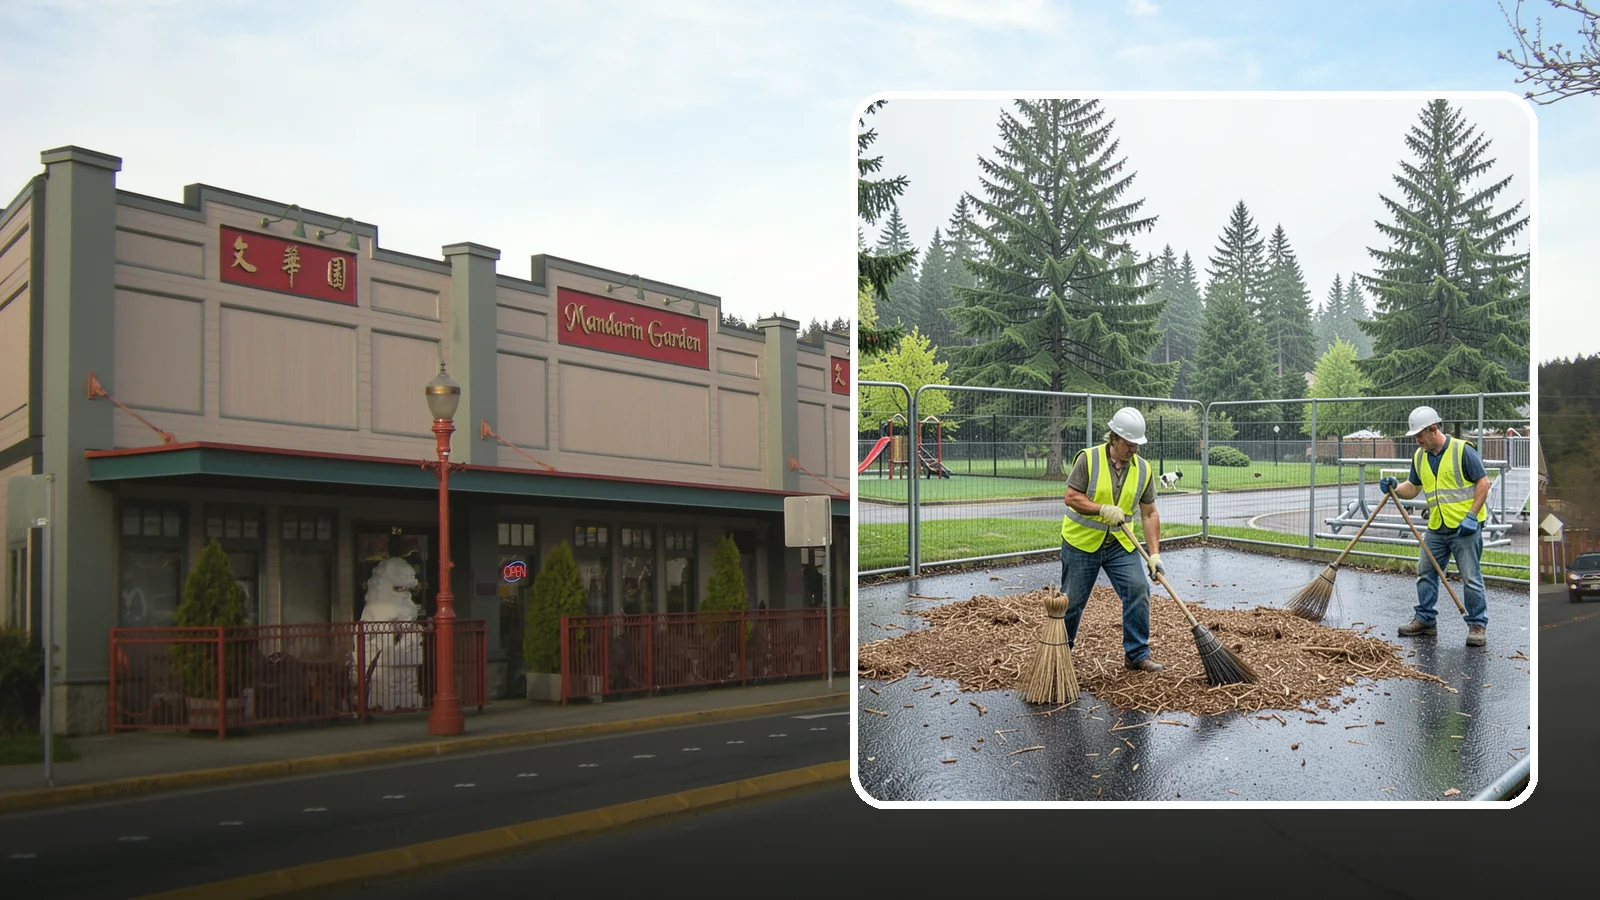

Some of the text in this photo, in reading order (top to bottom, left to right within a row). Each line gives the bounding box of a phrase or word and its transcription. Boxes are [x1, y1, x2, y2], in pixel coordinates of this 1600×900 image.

[231, 236, 346, 290] 文華園
[565, 303, 701, 352] Mandarin Garden
[503, 565, 527, 578] OPEN
